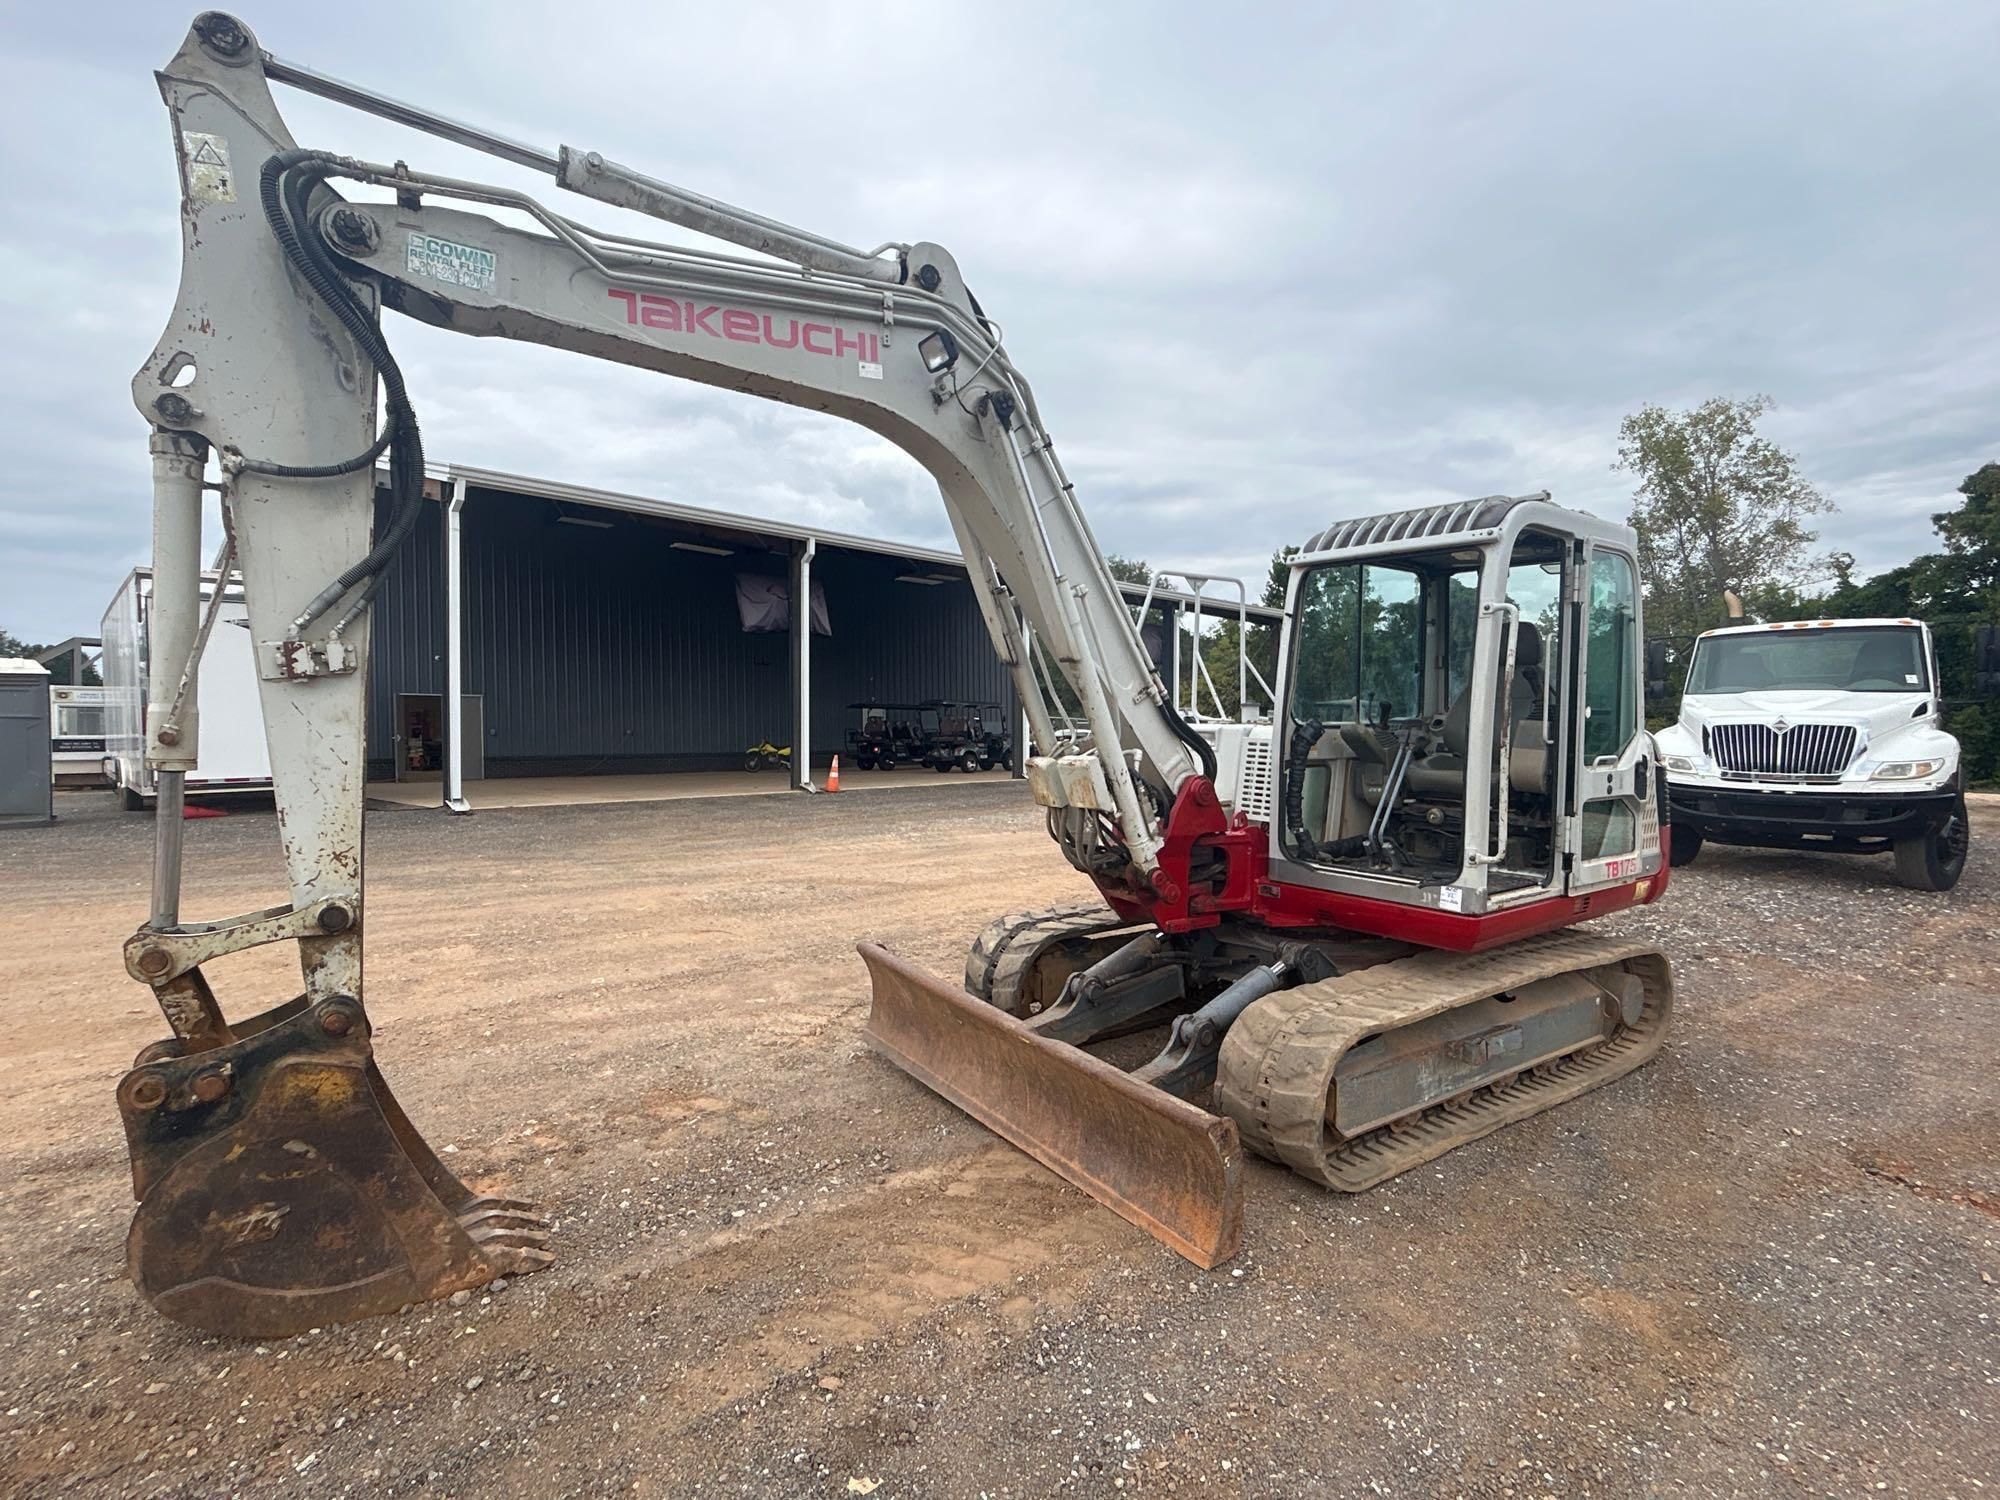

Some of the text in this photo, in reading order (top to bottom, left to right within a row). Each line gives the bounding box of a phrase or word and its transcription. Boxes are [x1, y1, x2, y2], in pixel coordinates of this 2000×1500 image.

[409, 248, 493, 277] RENTAL FLEET
[426, 239, 494, 269] COWIN
[1605, 857, 1636, 878] TB175
